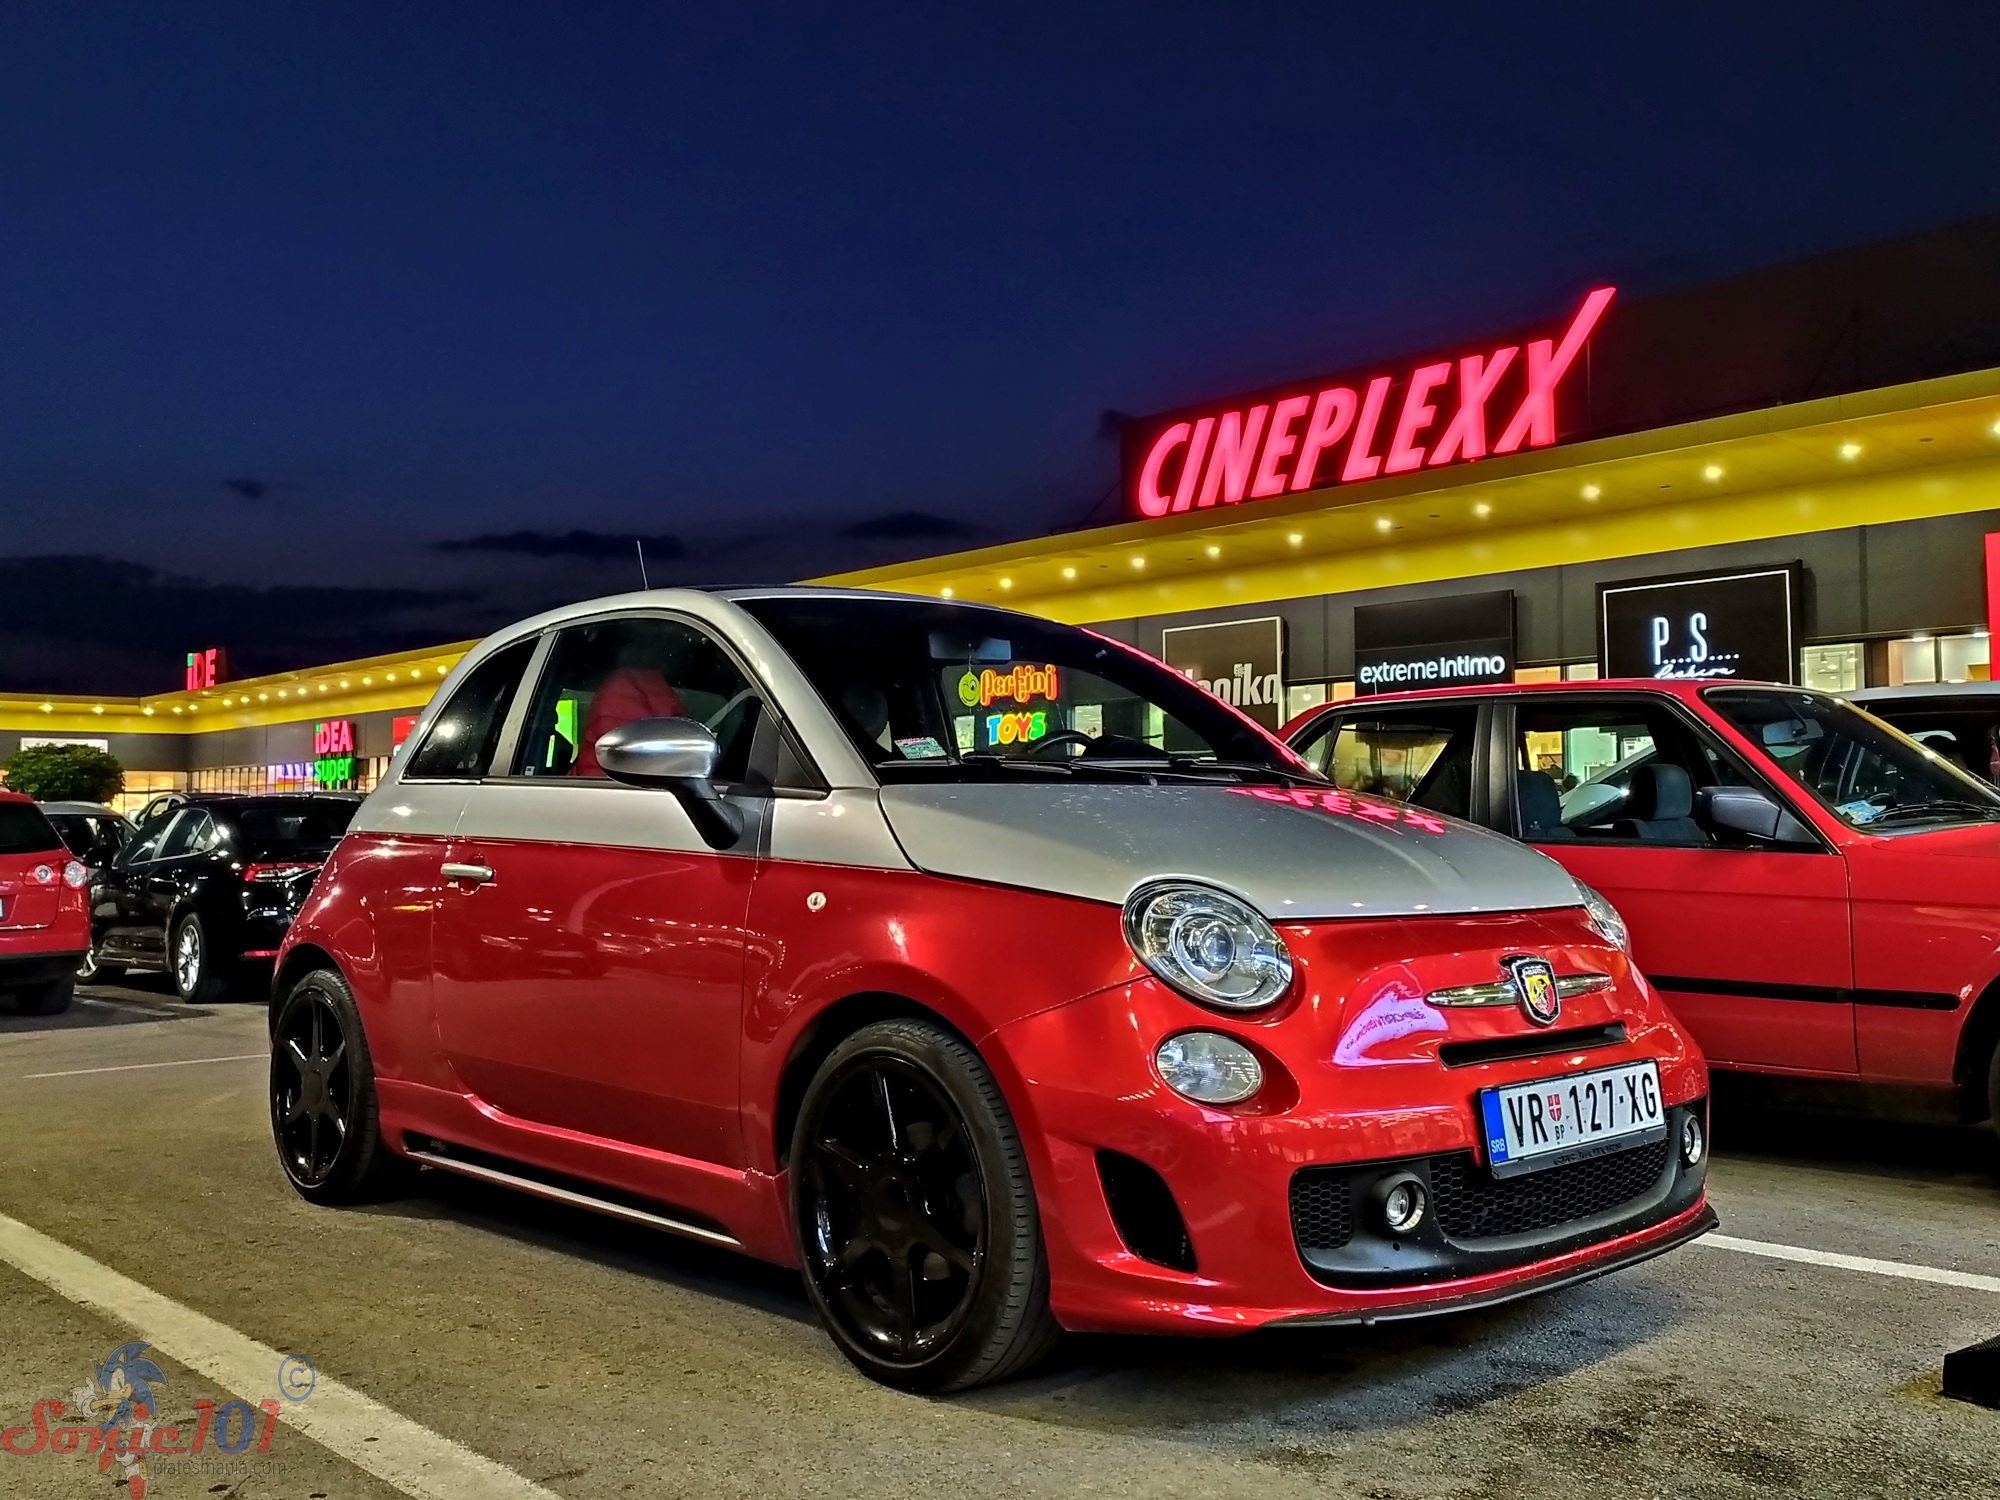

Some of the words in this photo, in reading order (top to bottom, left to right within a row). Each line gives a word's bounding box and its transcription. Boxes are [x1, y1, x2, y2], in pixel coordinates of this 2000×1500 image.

[1138, 286, 1617, 517] CINEPLEXX
[1360, 661, 1438, 684] extreme
[1440, 655, 1506, 679] intimo
[315, 720, 354, 755] iDEA
[986, 711, 1047, 746] TOYS
[314, 757, 353, 789] super
[1507, 1093, 1549, 1148] VR
[1491, 1138, 1506, 1154] SRB
